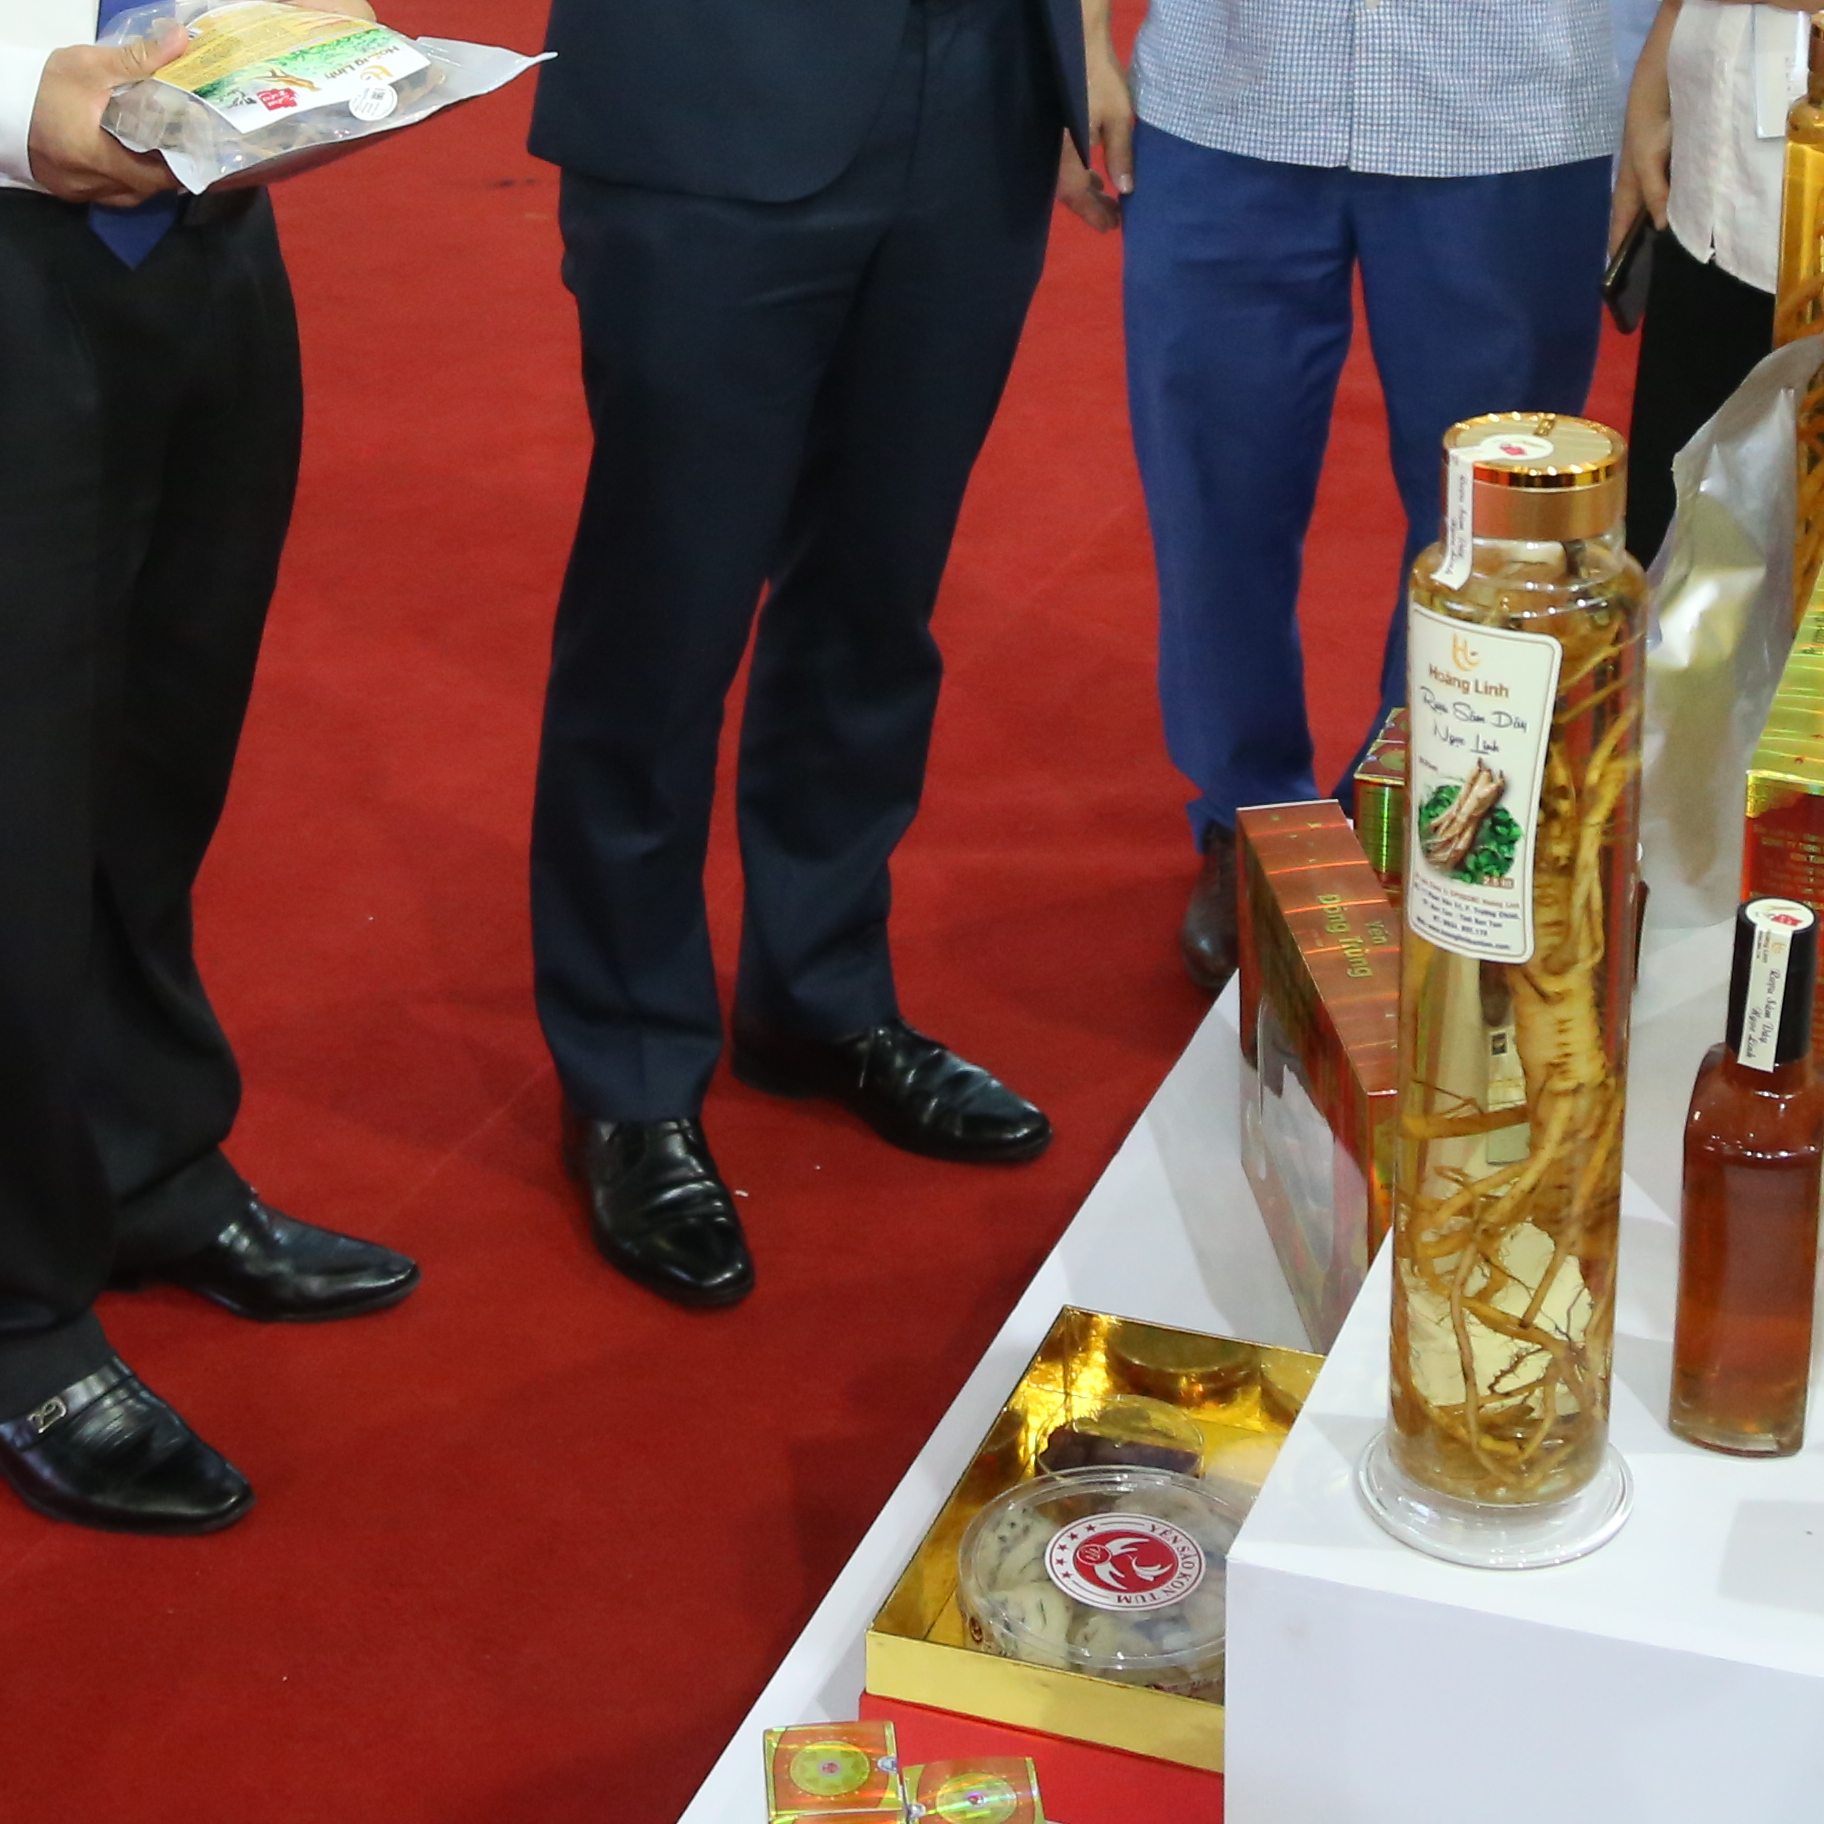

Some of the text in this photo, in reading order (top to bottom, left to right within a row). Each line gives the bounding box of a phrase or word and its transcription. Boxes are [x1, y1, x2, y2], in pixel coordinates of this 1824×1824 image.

[1429, 663, 1510, 698] Hoàng Linh
[1116, 1523, 1199, 1604] YẾN SÀO KON TUM
